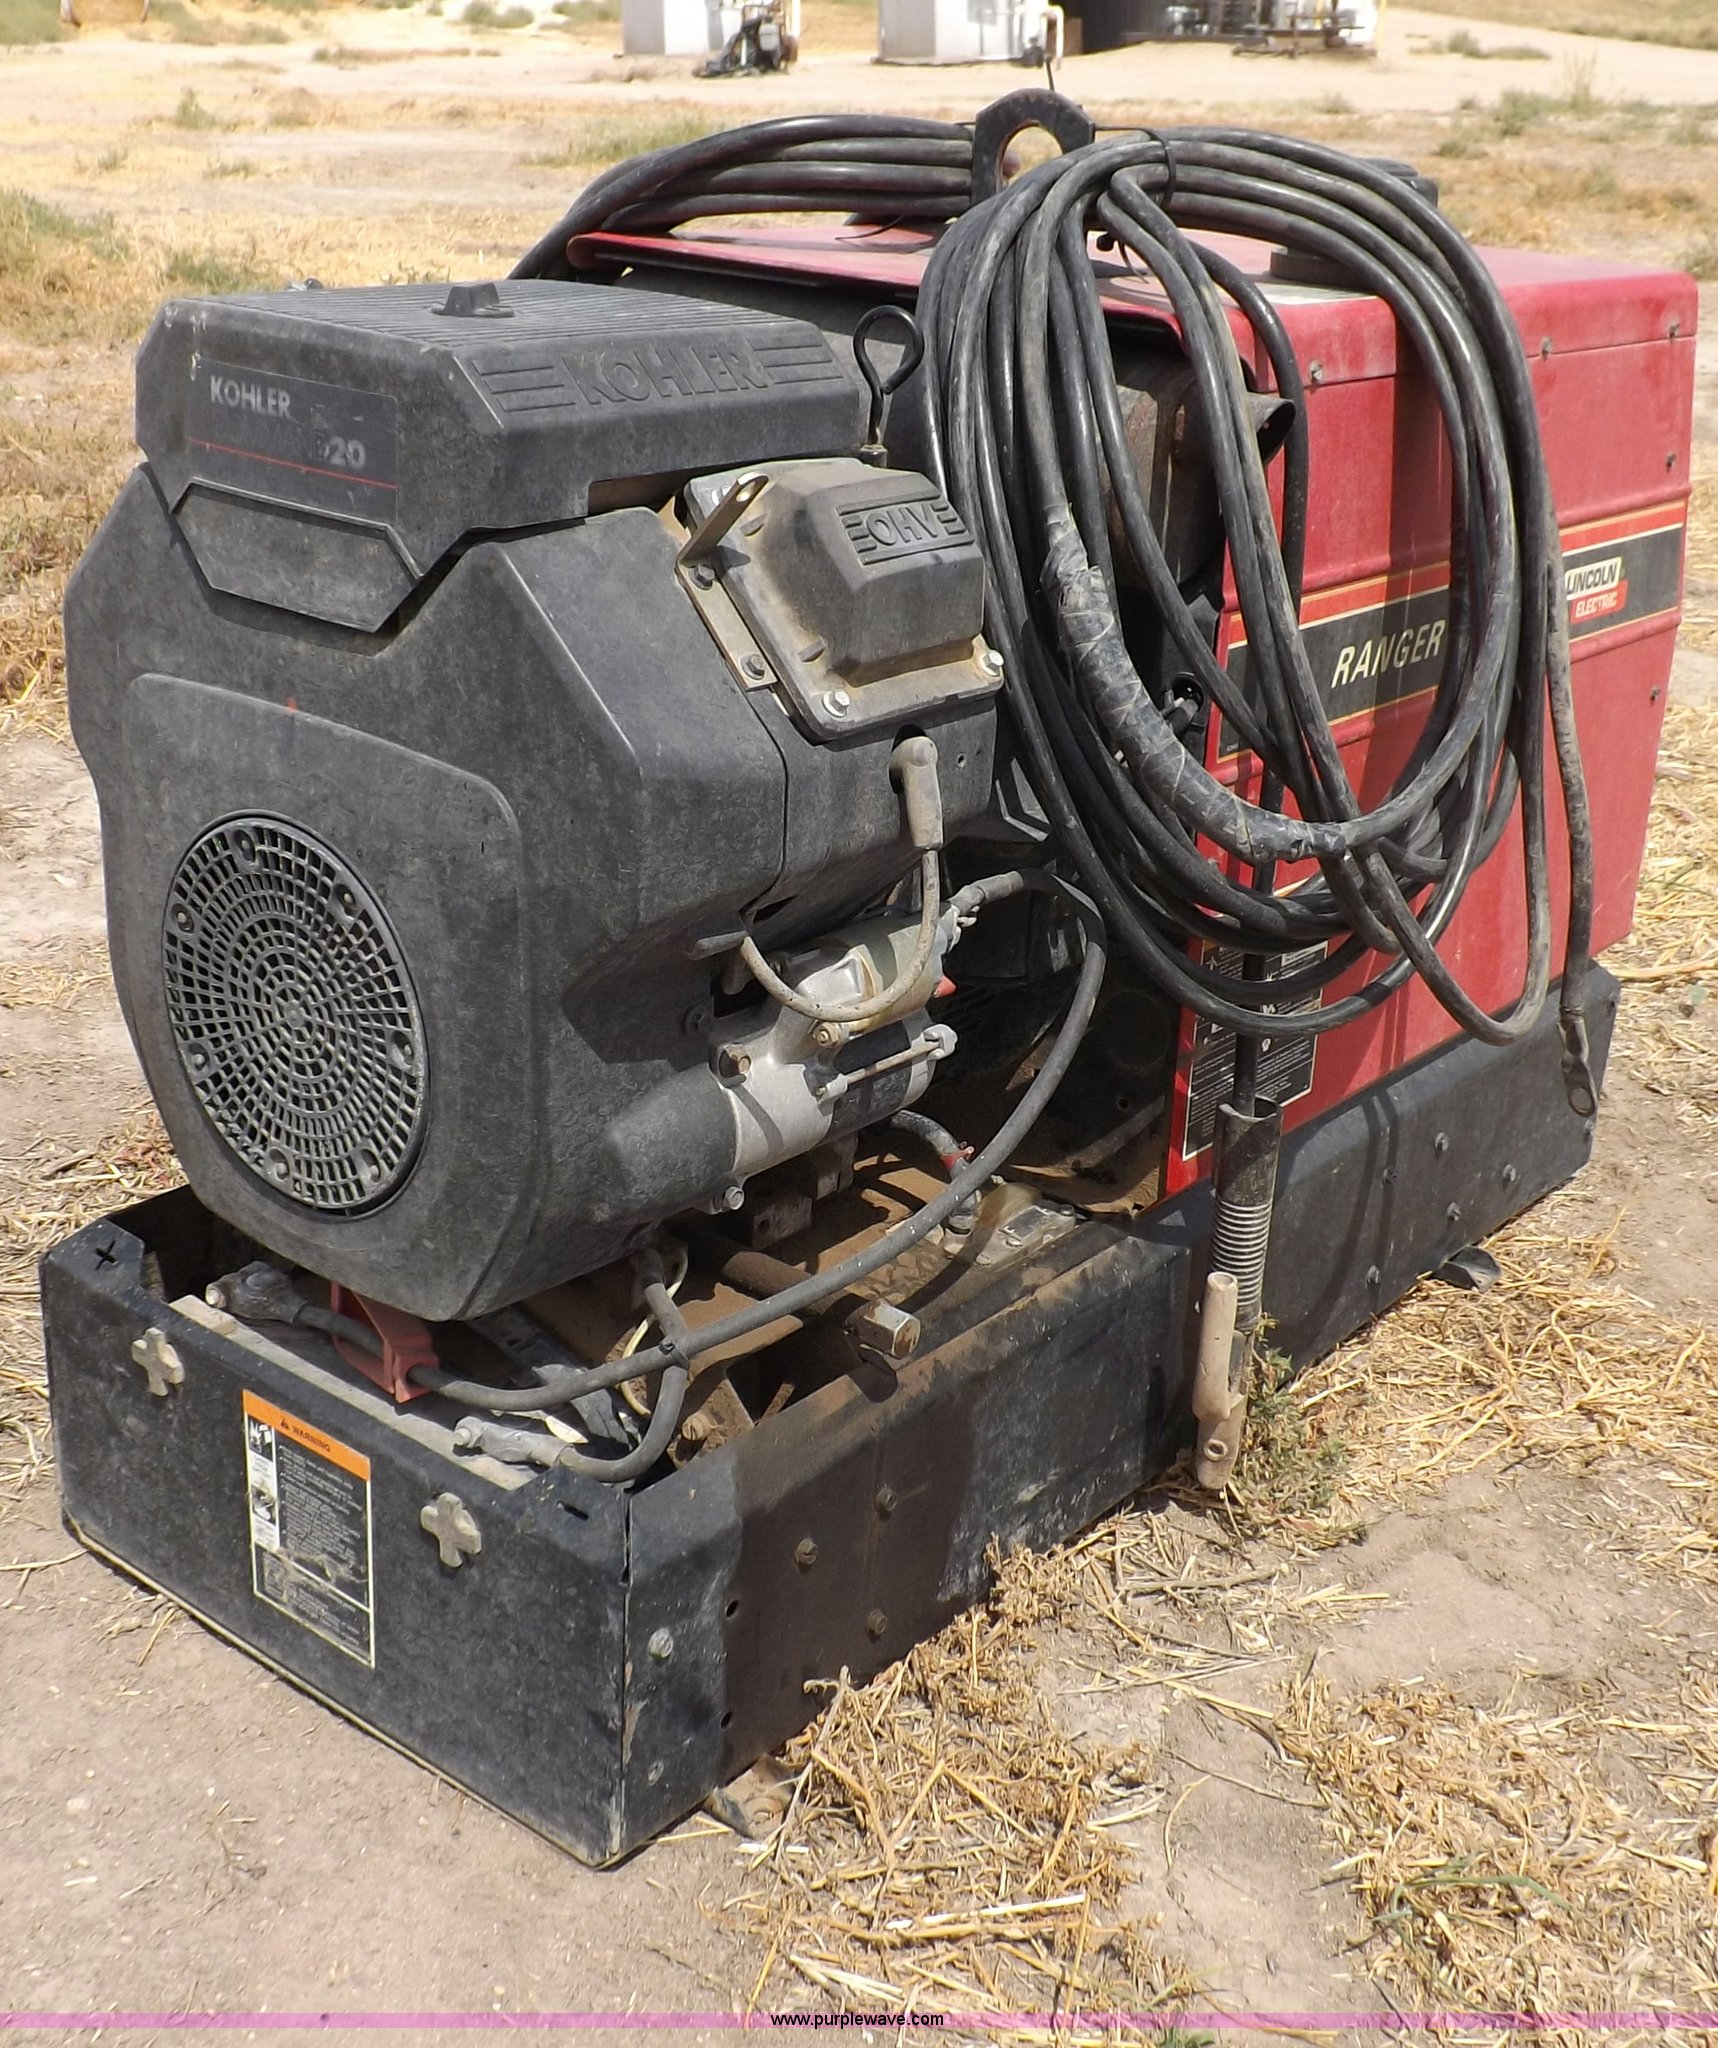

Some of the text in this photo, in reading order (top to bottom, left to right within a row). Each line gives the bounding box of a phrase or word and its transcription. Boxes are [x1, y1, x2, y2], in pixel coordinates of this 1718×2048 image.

[560, 338, 769, 403] KOHLER
[210, 375, 291, 419] KOHLER
[865, 503, 939, 547] OHV
[1566, 562, 1619, 594] LINCOLN
[1575, 591, 1618, 618] ELECTRIC
[1330, 619, 1447, 689] RANGER
[291, 1425, 332, 1453] WARNING
